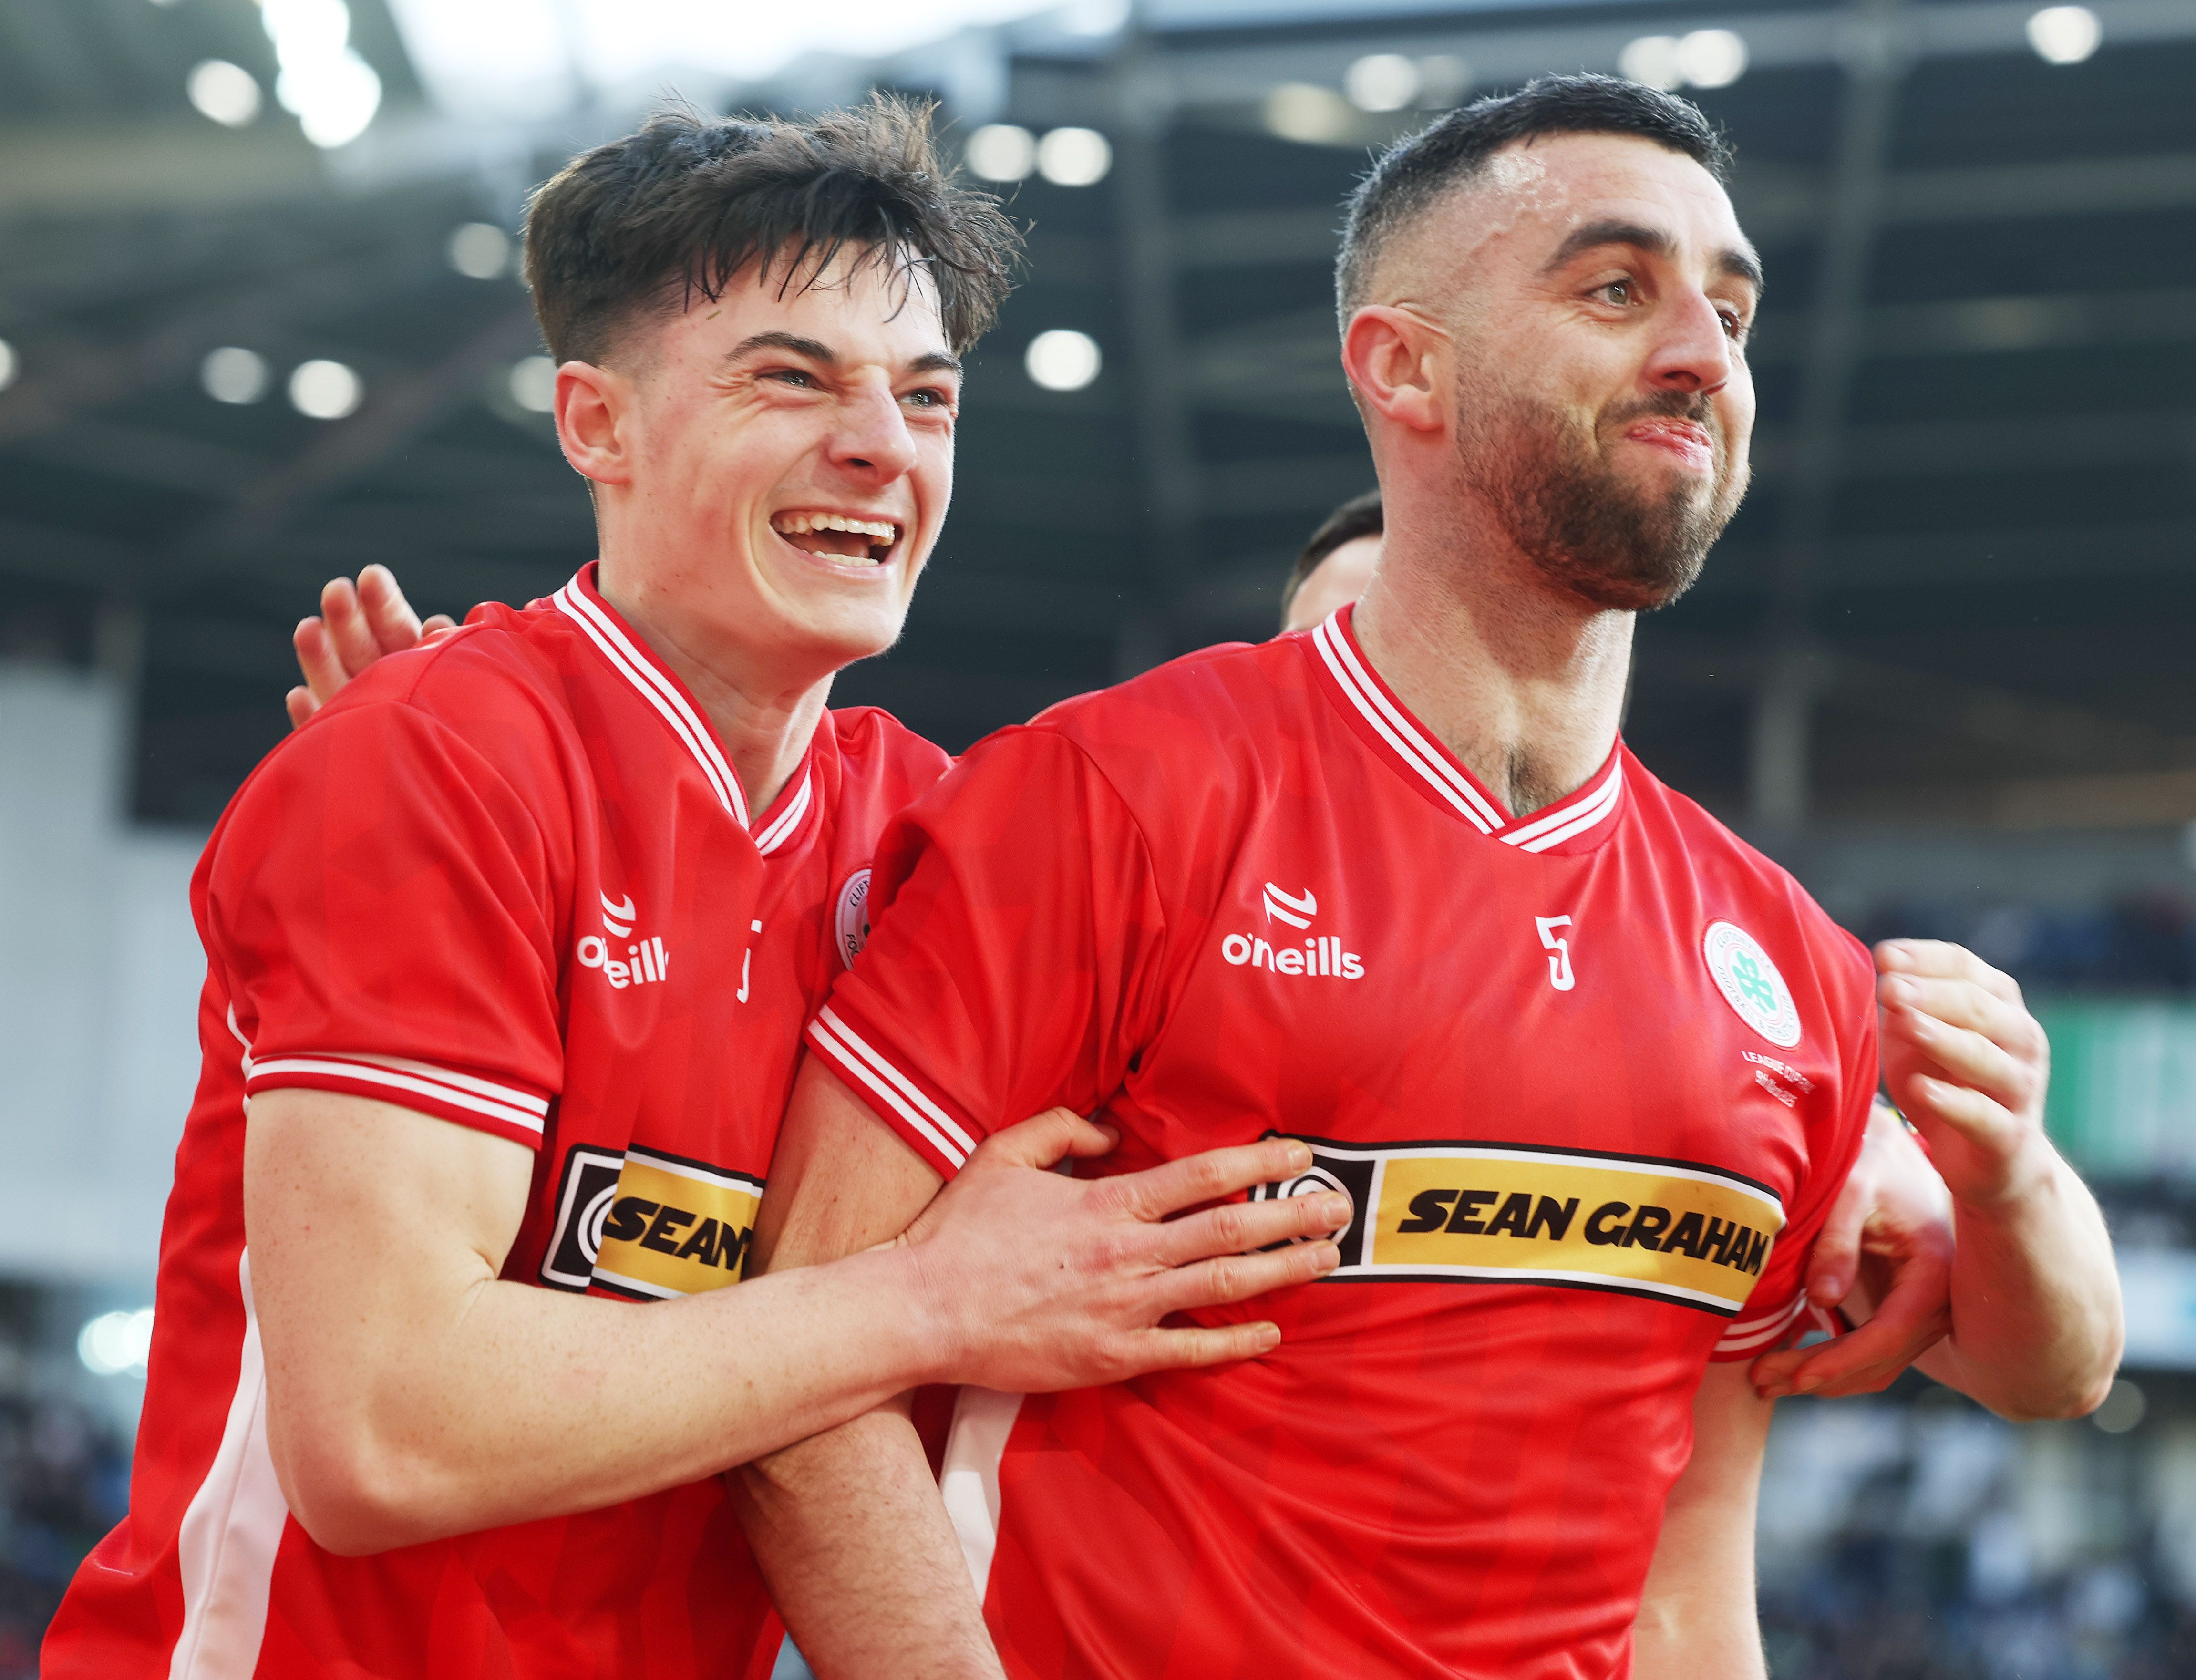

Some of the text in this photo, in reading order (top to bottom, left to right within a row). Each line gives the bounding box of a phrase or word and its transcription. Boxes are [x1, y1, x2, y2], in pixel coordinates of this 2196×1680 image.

[1535, 914, 1576, 991] 5
[602, 1196, 753, 1271] SEAN
[1397, 1189, 1769, 1277] SEAN GRAHAM
